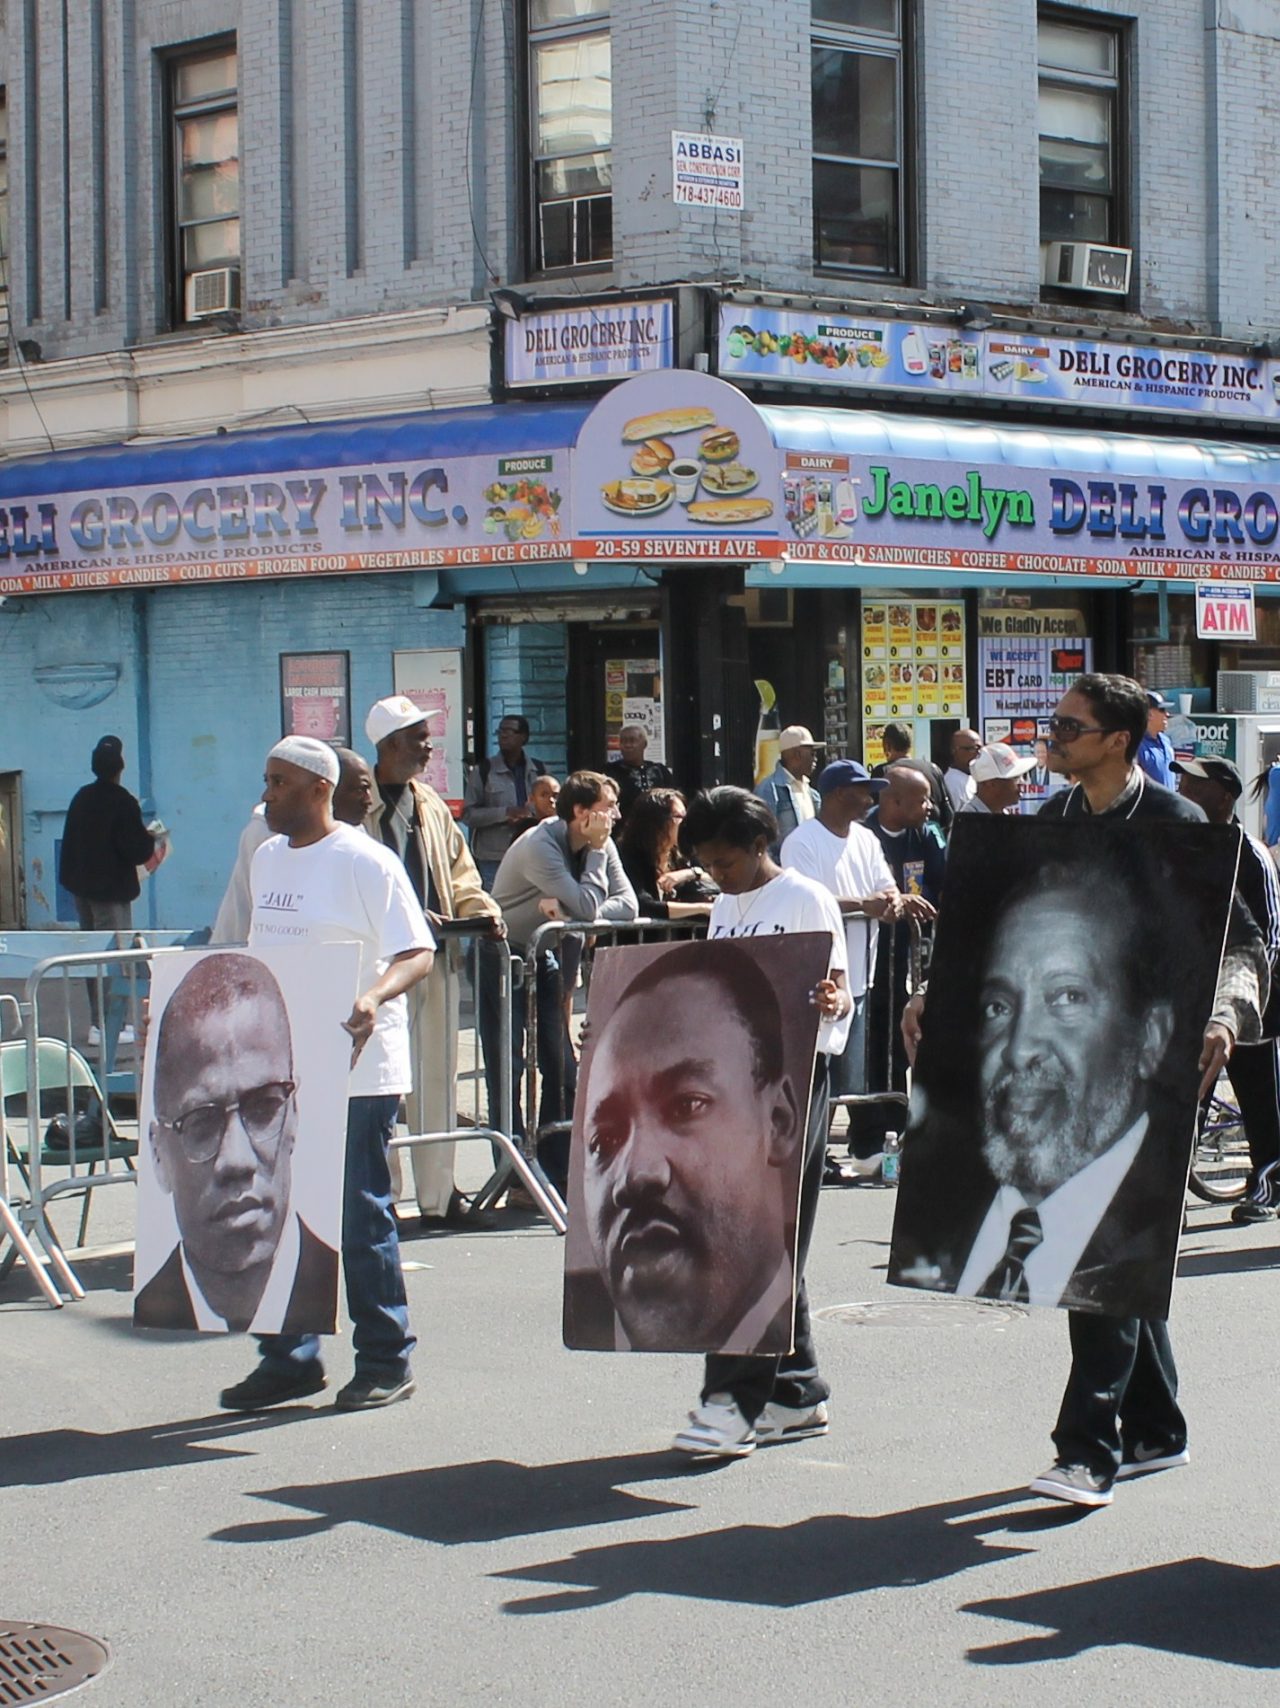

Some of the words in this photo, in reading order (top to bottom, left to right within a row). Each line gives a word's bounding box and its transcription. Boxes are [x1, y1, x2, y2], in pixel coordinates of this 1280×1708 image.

[676, 142, 741, 163] ABBASI
[526, 328, 557, 352] DELI
[561, 320, 626, 349] GROCERY
[630, 317, 658, 343] INC.
[825, 327, 875, 341] PRODUCE
[535, 352, 570, 366] AMERICAN
[579, 350, 612, 364] HISPANIC
[613, 347, 650, 360] PRODUCTS
[1004, 345, 1036, 355] DAIRY
[1059, 349, 1110, 376] DELI
[1116, 355, 1218, 386] GROCERY
[1223, 366, 1264, 390] INC.
[1073, 377, 1132, 390] AMERICAN
[1134, 383, 1143, 392] &
[1146, 384, 1196, 397] HISPANIC
[1198, 389, 1251, 402] PRODUCTS
[505, 459, 546, 472] PRODUCE
[801, 457, 834, 468] DAIRY
[69, 478, 327, 552] GROCERY
[339, 468, 469, 533] INC.
[862, 465, 1035, 539] Janelyn
[1048, 478, 1166, 540] DELI
[24, 557, 112, 573] AMERICAN
[117, 556, 130, 566] &
[135, 549, 219, 565] HISPANIC
[223, 542, 323, 559] PRODUCTS
[596, 540, 641, 556] 20-59
[644, 540, 718, 557] SEVENTH
[723, 540, 761, 557] AVE.
[1129, 546, 1215, 560] AMERICAN
[1219, 552, 1231, 560] &
[32, 575, 61, 589] MILK
[70, 571, 109, 588] JUICES
[119, 567, 170, 584] CANDIES
[180, 565, 213, 580] COLD
[215, 562, 246, 577] CUTS
[257, 558, 306, 574] FROZEN
[311, 556, 347, 572] FOOD
[359, 550, 444, 569] VEGETABLES
[457, 547, 480, 563] ICE
[492, 545, 514, 562] ICE
[520, 542, 572, 559] CREAM
[787, 542, 815, 559] HOT
[818, 544, 829, 559] &
[831, 544, 866, 560] COLD
[868, 547, 951, 566] SANDWICHES
[962, 552, 1006, 568] COFFEE
[1016, 555, 1087, 573] CHOCOLATE
[1096, 559, 1127, 575] SODA
[1136, 562, 1165, 576] MILK
[1173, 563, 1212, 578] JUICES
[1220, 566, 1266, 580] CANDIES
[981, 616, 1002, 634] We
[1005, 616, 1040, 635] Gladly
[1202, 603, 1249, 632] ATM
[985, 668, 1015, 688] EBT
[1018, 675, 1042, 687] CARD
[1196, 722, 1229, 743] port
